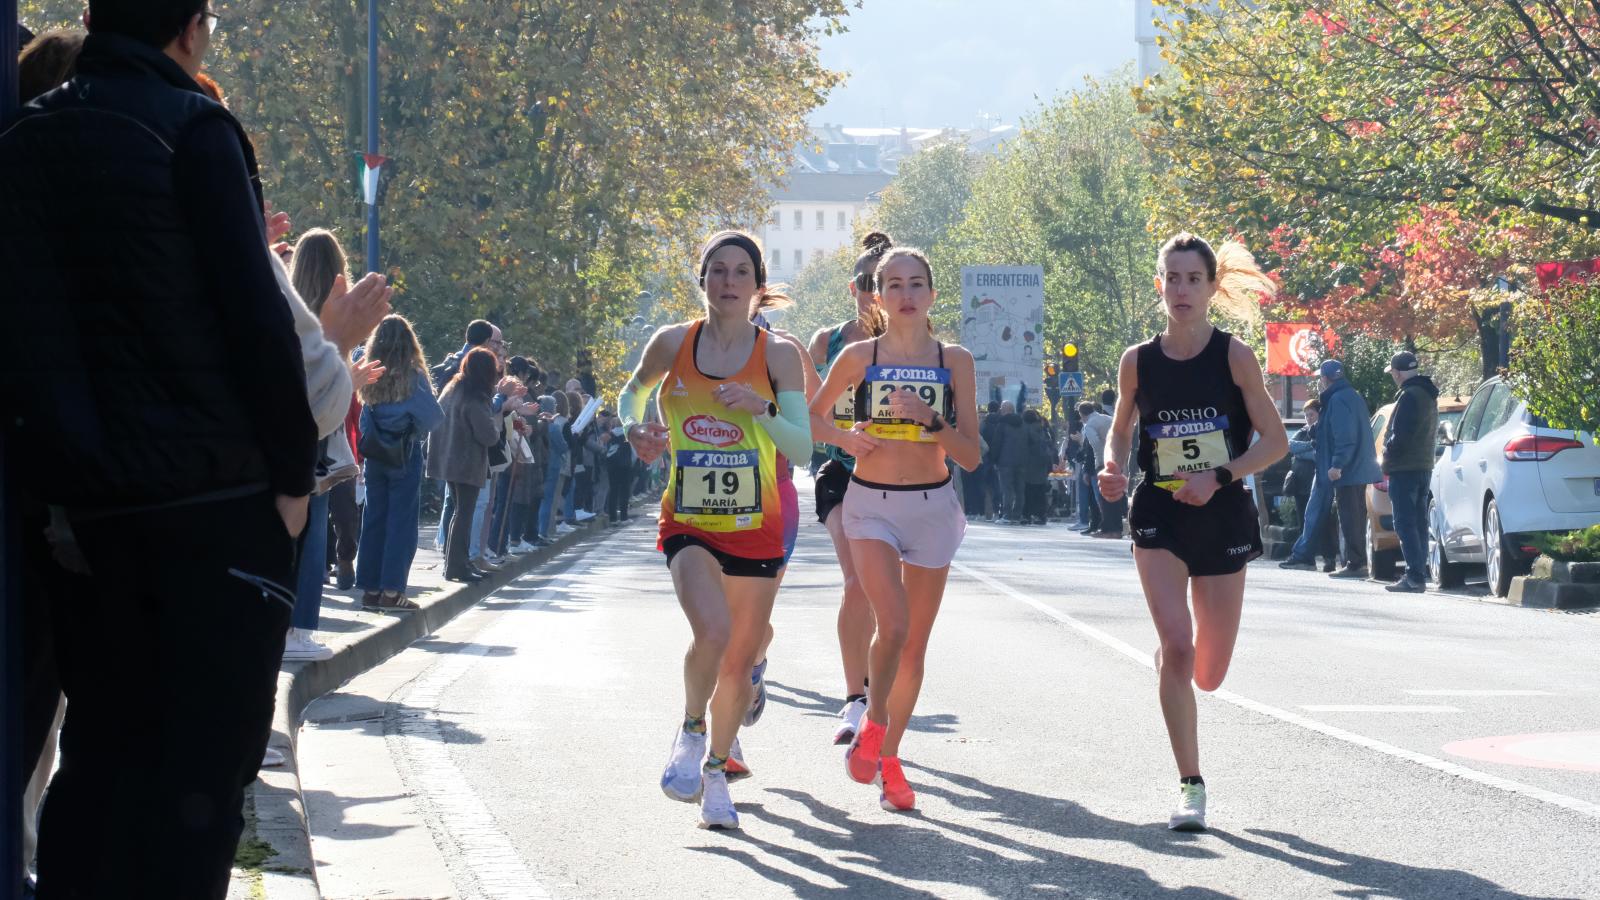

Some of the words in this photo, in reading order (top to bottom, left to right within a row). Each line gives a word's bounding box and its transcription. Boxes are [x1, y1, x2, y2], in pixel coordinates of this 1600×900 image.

[976, 273, 1040, 287] ERRENTERIA
[1158, 406, 1218, 422] OYSHO
[688, 420, 739, 439] Serrano
[1182, 438, 1201, 460] 5
[1177, 461, 1212, 473] MAITE
[702, 470, 740, 495] 19
[702, 497, 738, 507] MARÍA
[1226, 543, 1252, 556] OYSHO
